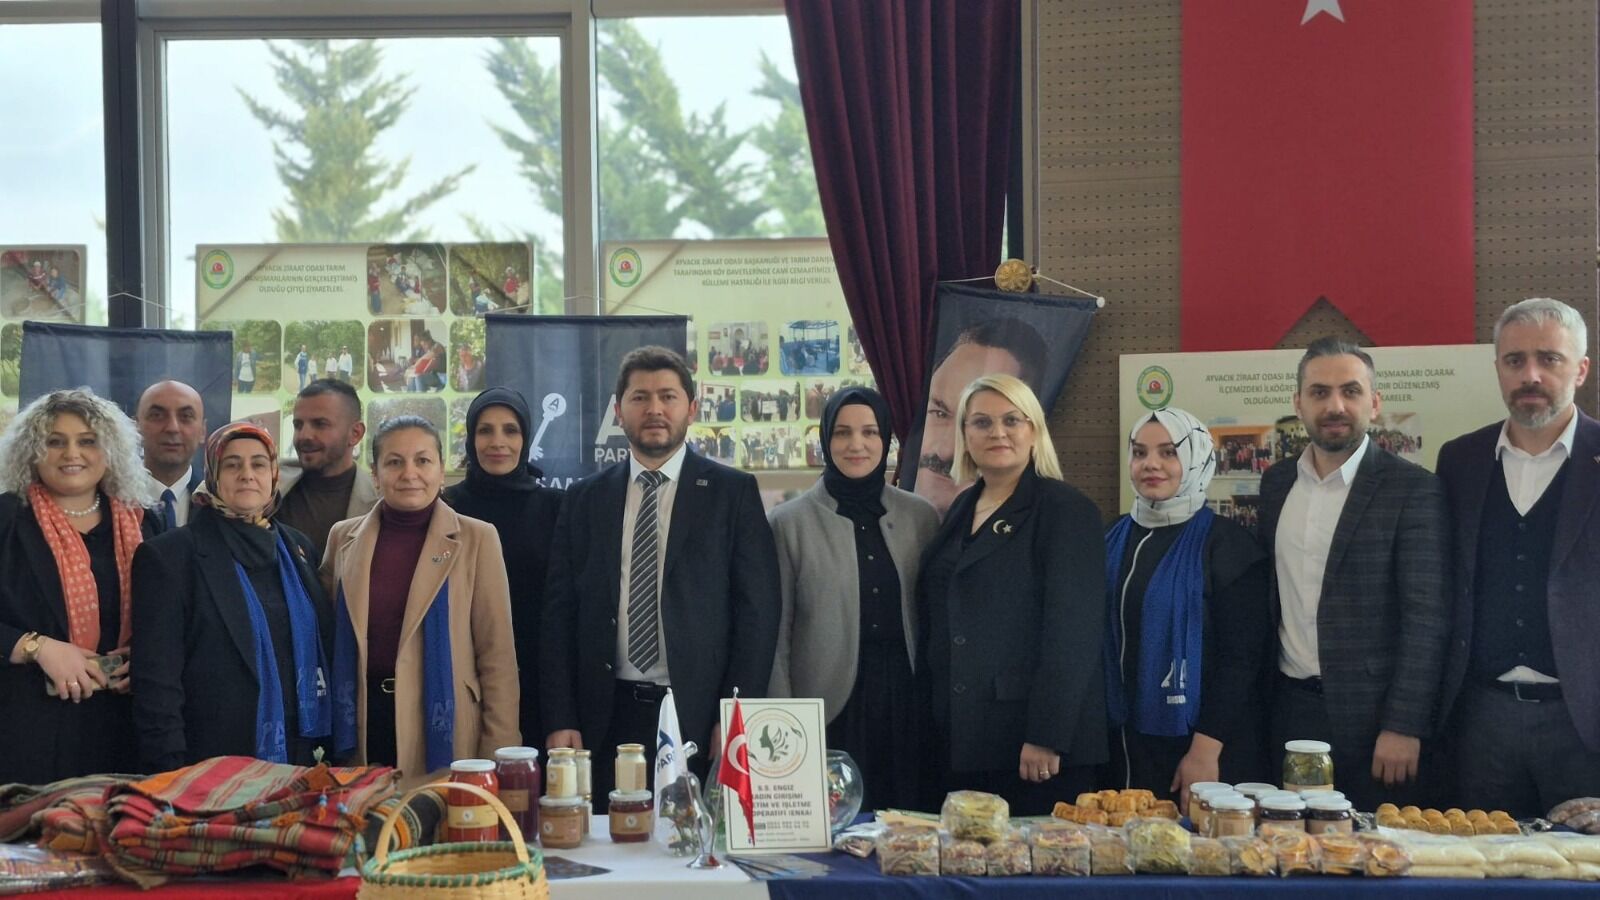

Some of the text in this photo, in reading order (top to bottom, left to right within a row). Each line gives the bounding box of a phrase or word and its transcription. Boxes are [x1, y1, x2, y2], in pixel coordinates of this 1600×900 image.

[723, 257, 743, 265] ODASI
[791, 256, 810, 264] TARIM
[305, 264, 325, 272] ODASI
[326, 264, 346, 272] TARIM
[674, 268, 713, 276] TARAFINDAN
[1206, 374, 1234, 382] AYVACIK
[1262, 372, 1284, 380] ODASI
[1425, 368, 1455, 377] OLARAK
[1244, 395, 1291, 405] OLDUĞUMUZ
